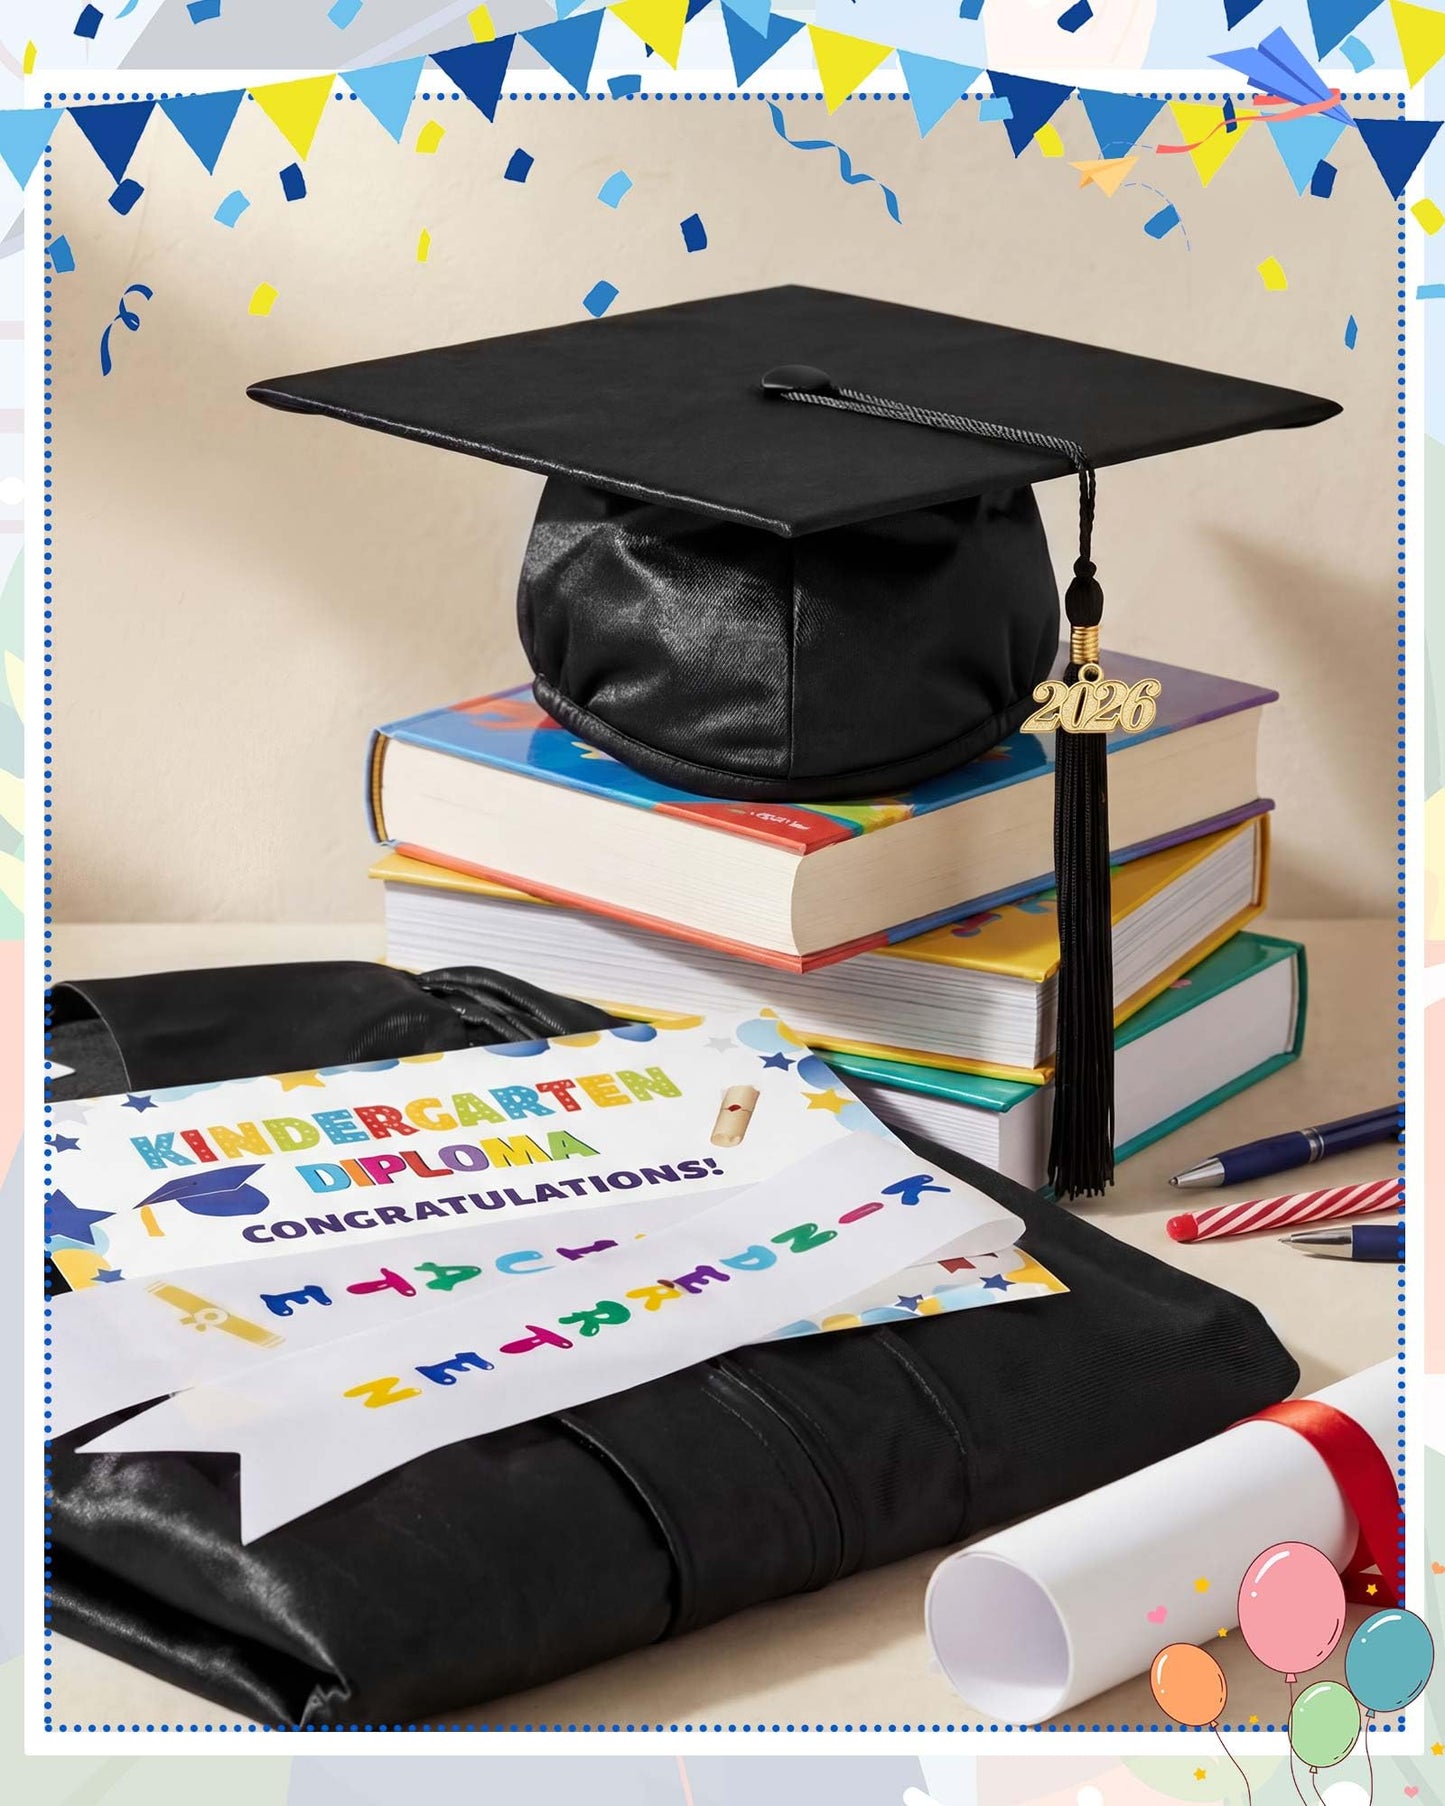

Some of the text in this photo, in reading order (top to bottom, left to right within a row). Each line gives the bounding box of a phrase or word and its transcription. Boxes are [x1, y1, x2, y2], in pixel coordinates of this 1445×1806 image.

[1020, 678, 1161, 734] 2026
[130, 1066, 683, 1169] KINDERGARTEN
[295, 1130, 601, 1194] DIPLOMA
[241, 1157, 725, 1244] CONGRATULATIONS!
